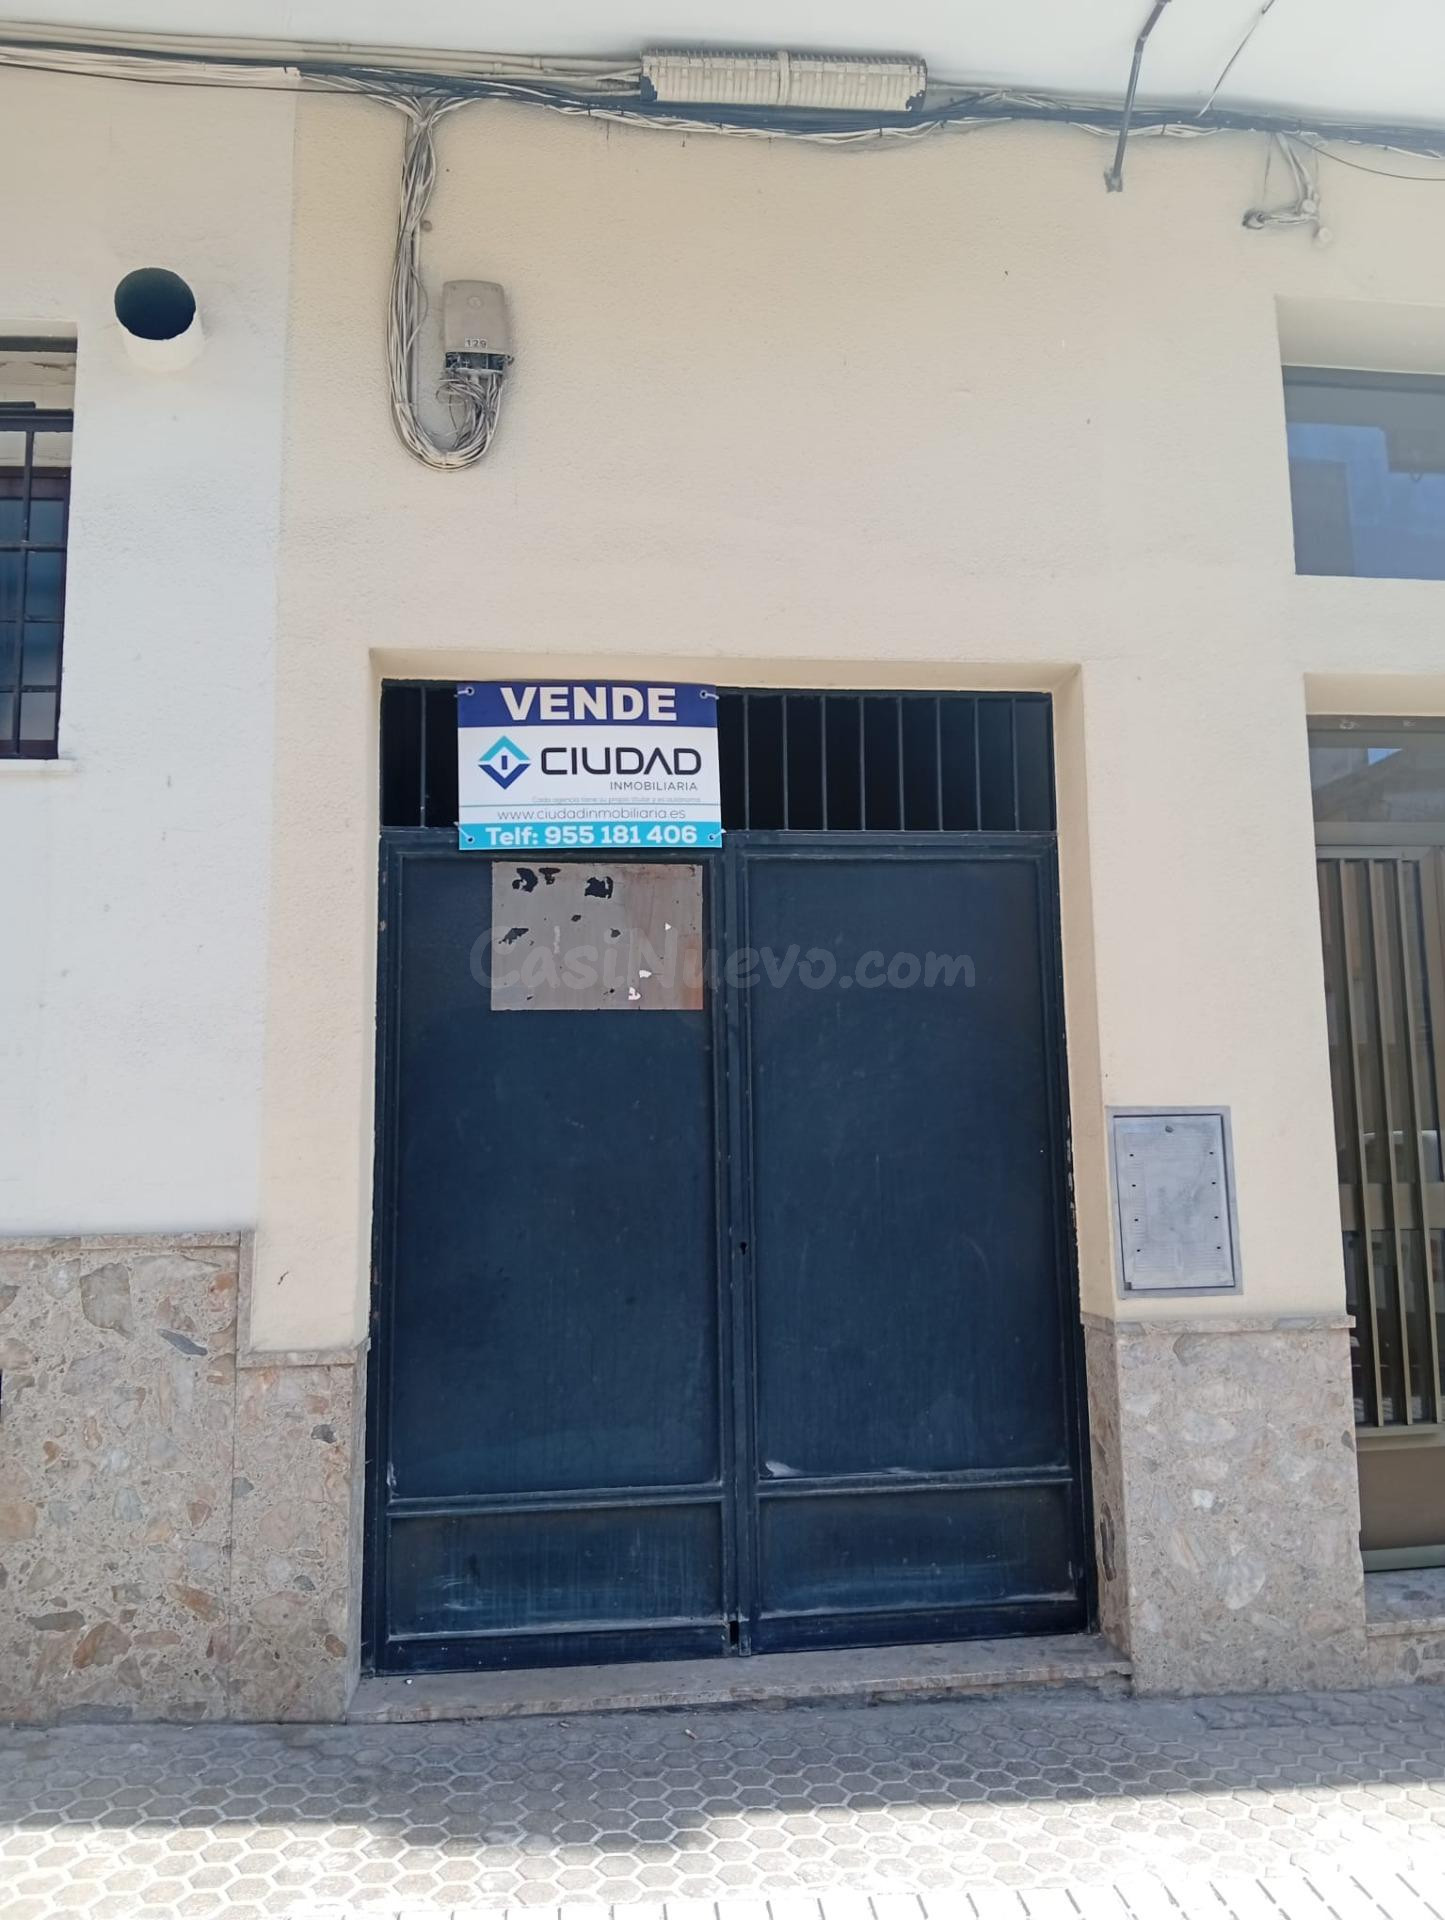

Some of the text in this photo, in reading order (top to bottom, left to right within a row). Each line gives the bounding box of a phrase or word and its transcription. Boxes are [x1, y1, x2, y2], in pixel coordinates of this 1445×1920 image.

[466, 339, 487, 349] 129
[500, 687, 678, 721] VENDE
[540, 746, 702, 775] CIUDAD
[609, 781, 699, 791] INMOBILIARIA
[497, 807, 686, 820] www.ciudadinmobiliaria.es
[485, 825, 698, 845] Telf: 955 181 406
